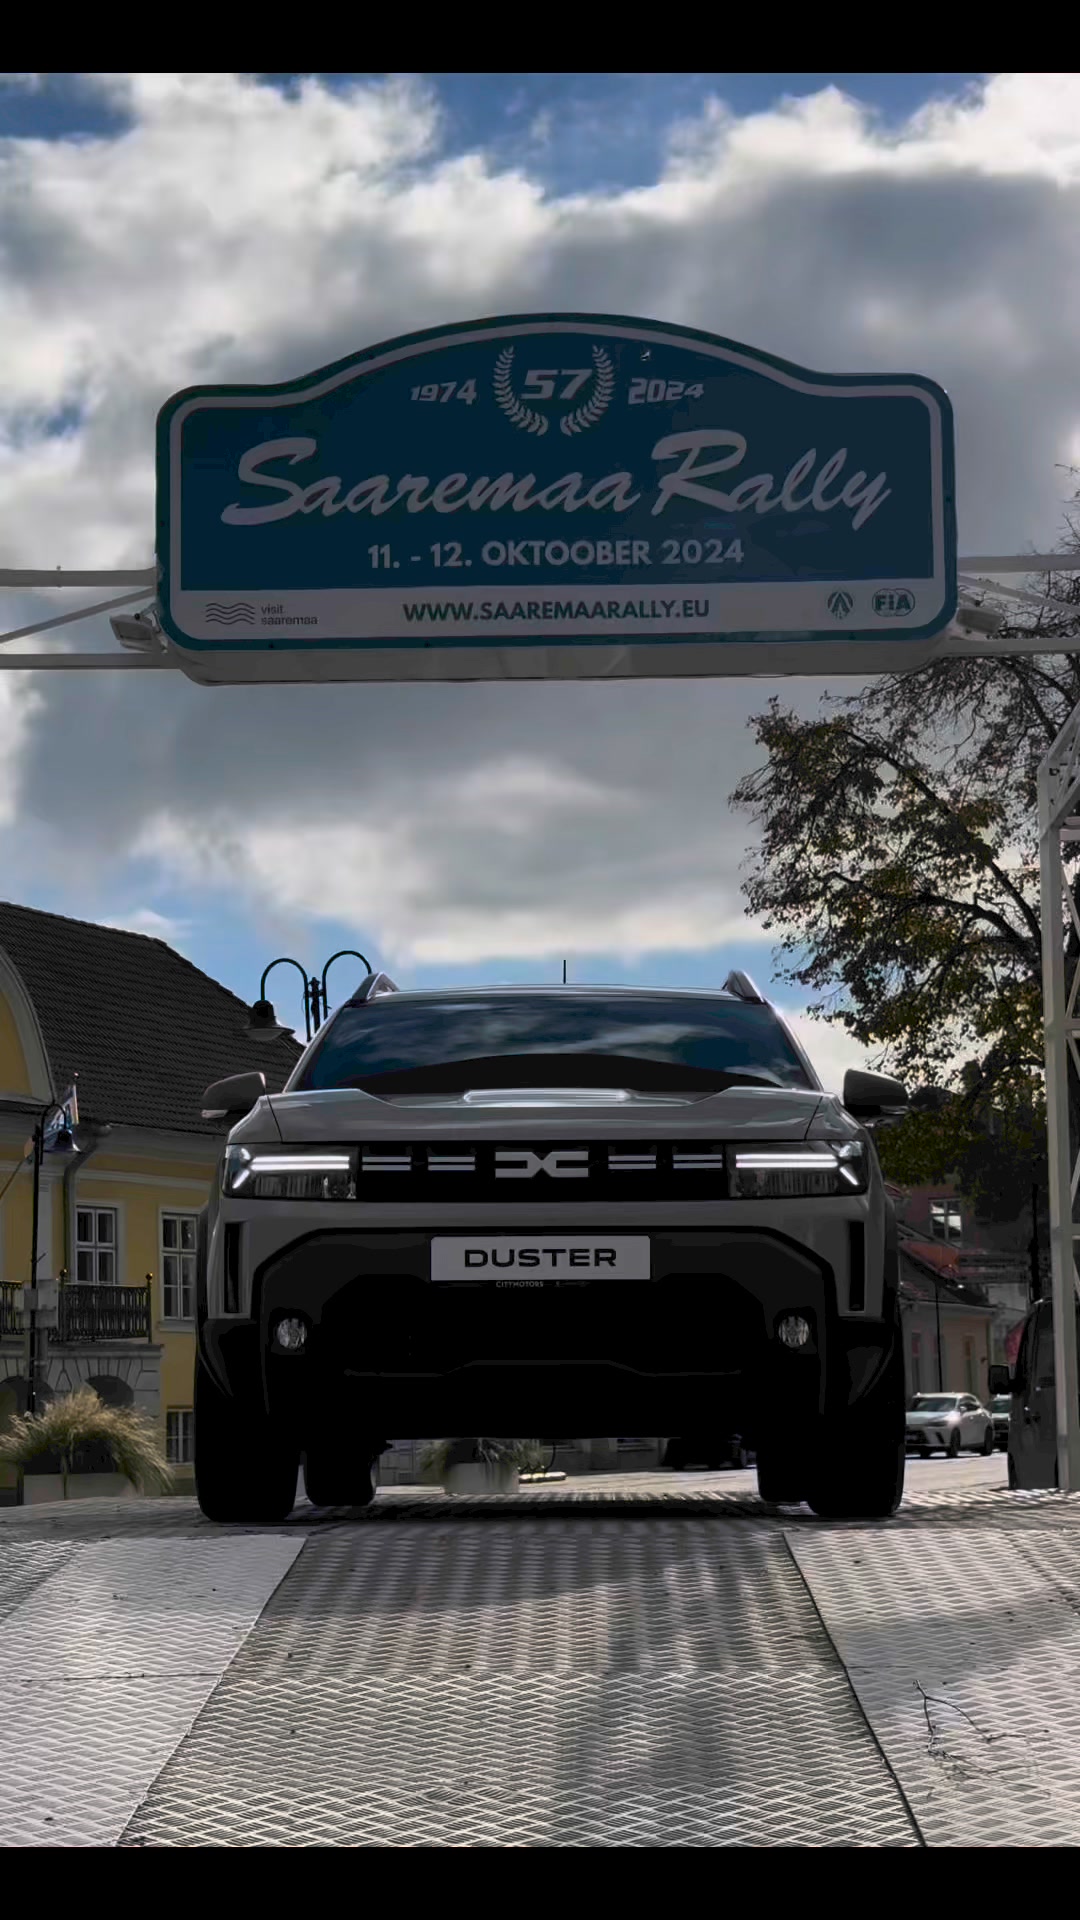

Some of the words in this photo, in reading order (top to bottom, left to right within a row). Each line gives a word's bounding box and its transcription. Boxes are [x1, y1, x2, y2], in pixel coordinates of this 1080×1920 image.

[410, 378, 477, 405] 1974
[520, 368, 593, 400] 57
[628, 377, 704, 405] 2024
[221, 436, 641, 526] Saaremaa
[651, 429, 891, 530] Rally
[368, 543, 400, 569] 11.
[430, 542, 472, 568] 12.
[481, 540, 652, 567] OKTOOBER
[660, 539, 744, 564] 2024
[261, 604, 284, 615] visit
[403, 600, 710, 621] WWW.SAAREMAARALLY.EU
[875, 594, 911, 611] FIA
[261, 615, 318, 626] saaremaa
[464, 1248, 617, 1268] DUSTER
